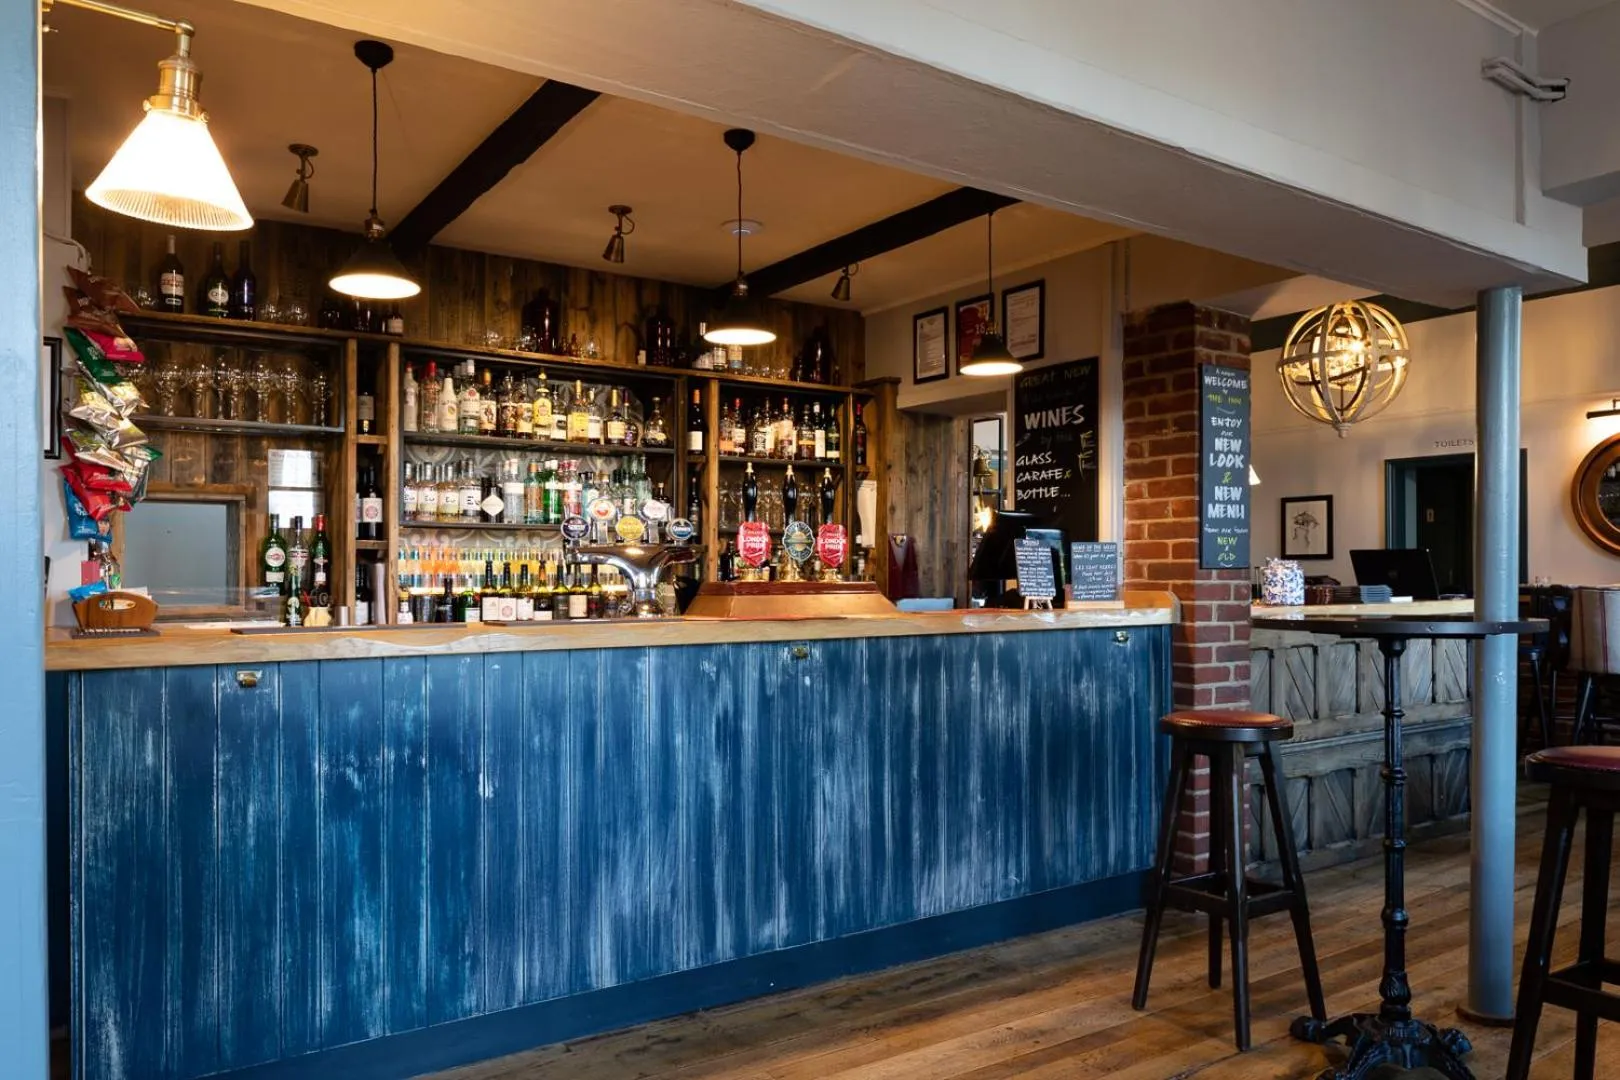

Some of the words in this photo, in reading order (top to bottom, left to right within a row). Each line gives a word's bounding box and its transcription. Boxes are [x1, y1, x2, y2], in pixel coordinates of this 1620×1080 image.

[1204, 375, 1248, 390] WELCOME
[1024, 404, 1085, 430] WINES
[1210, 416, 1243, 428] ENJOY
[1214, 437, 1242, 453] NEW
[1433, 439, 1474, 448] TOILETS
[1209, 452, 1245, 469] LOOK
[1016, 468, 1063, 484] CARAFE
[1214, 485, 1243, 501] NEW
[1207, 503, 1245, 519] MENU
[1217, 535, 1238, 546] NEW
